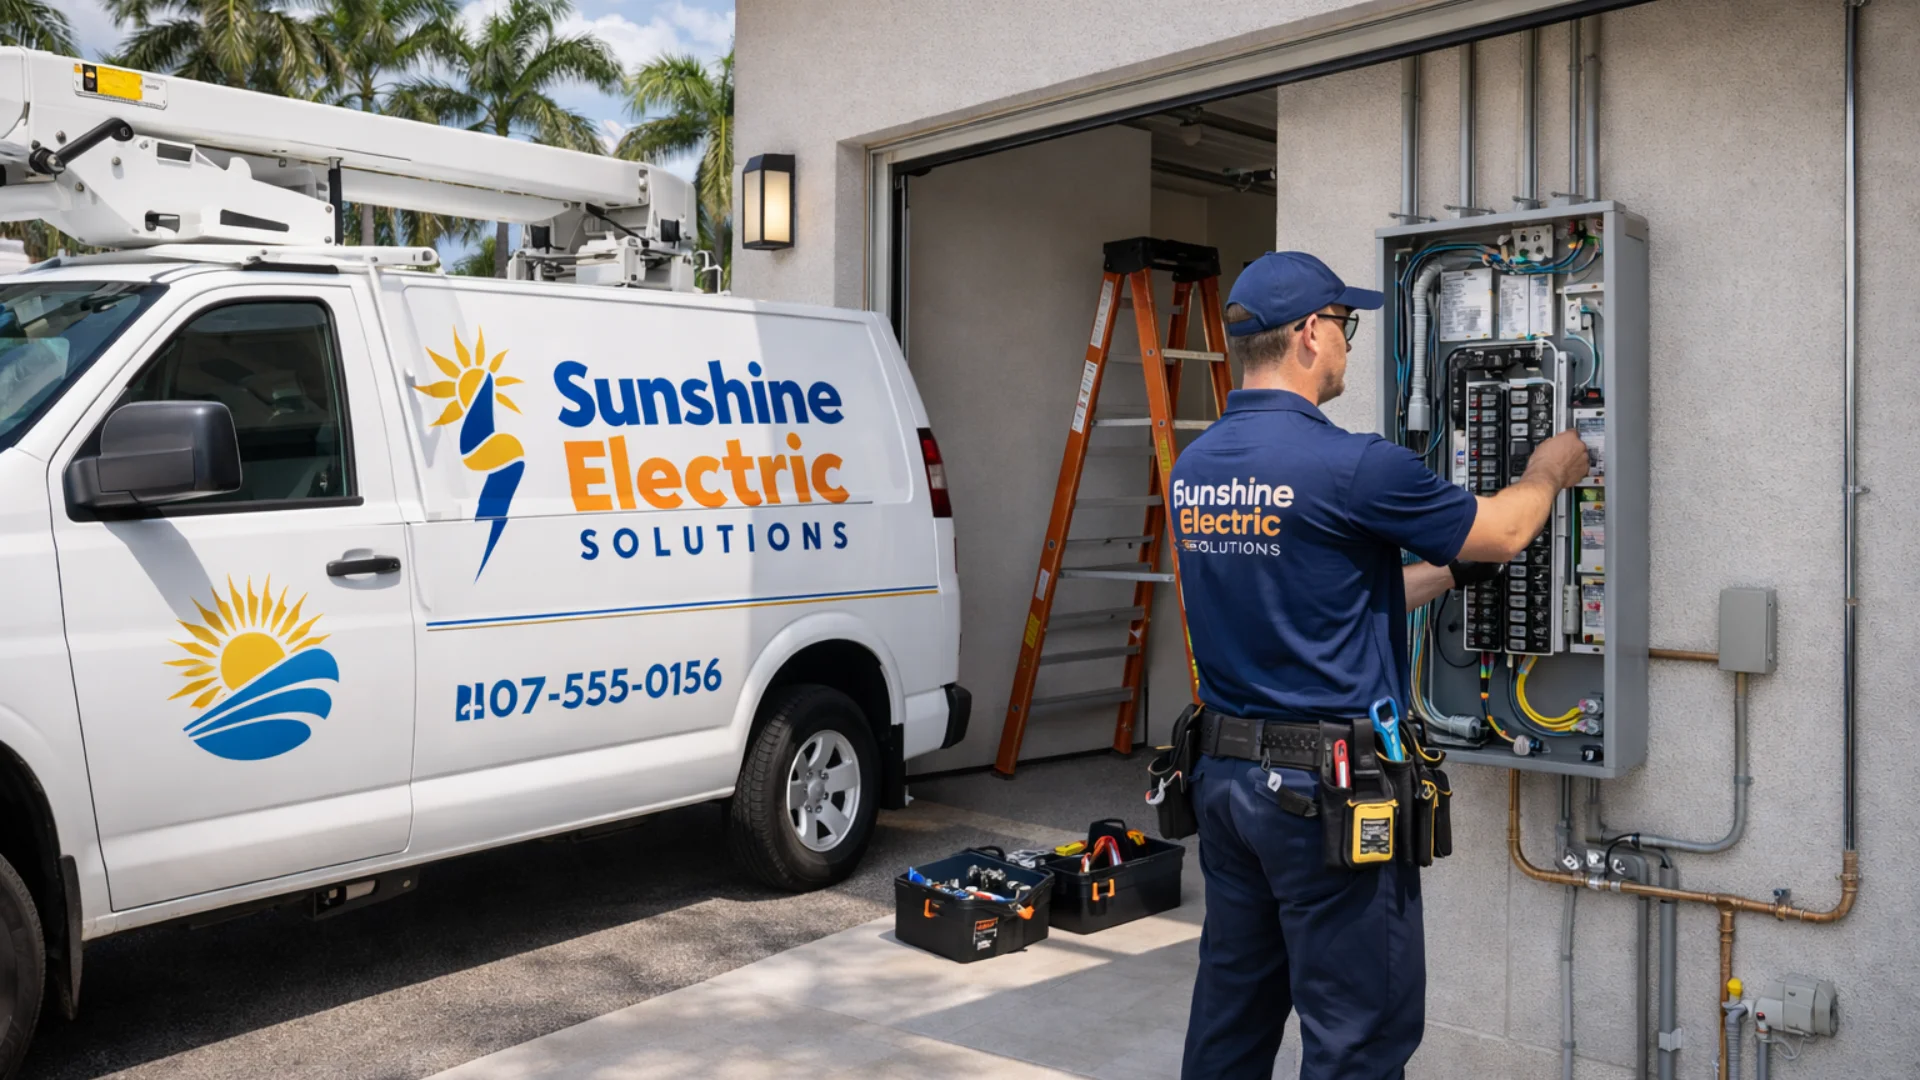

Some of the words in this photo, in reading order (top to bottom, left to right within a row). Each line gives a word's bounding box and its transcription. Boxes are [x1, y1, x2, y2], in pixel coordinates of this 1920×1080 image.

[553, 360, 845, 428] Sunshine
[563, 432, 850, 513] Electric
[579, 521, 849, 561] SOLUTIONS
[1179, 506, 1281, 537] Electric
[1182, 538, 1281, 556] OLUTIONS
